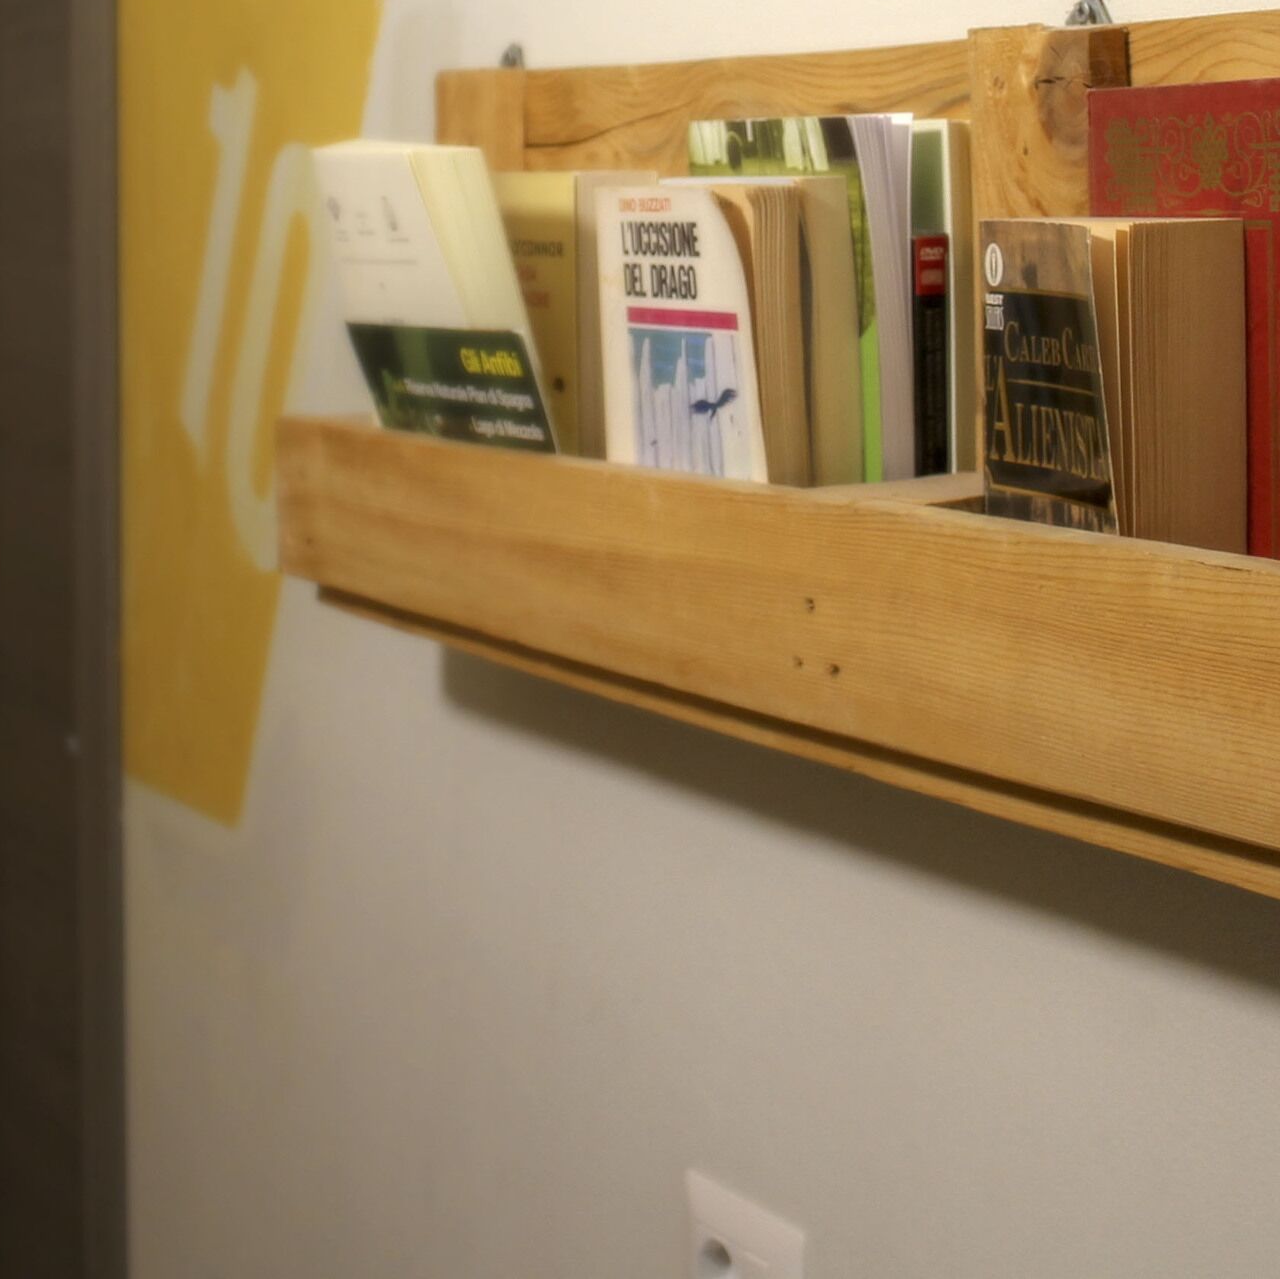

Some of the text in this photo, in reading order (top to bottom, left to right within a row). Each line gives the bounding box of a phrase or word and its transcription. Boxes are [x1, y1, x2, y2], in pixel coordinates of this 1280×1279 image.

[621, 221, 700, 257] L'UCCISIONE
[624, 262, 698, 300] DEL DRAGO
[1004, 321, 1062, 367] CALEB
[480, 349, 524, 378] Anfibi
